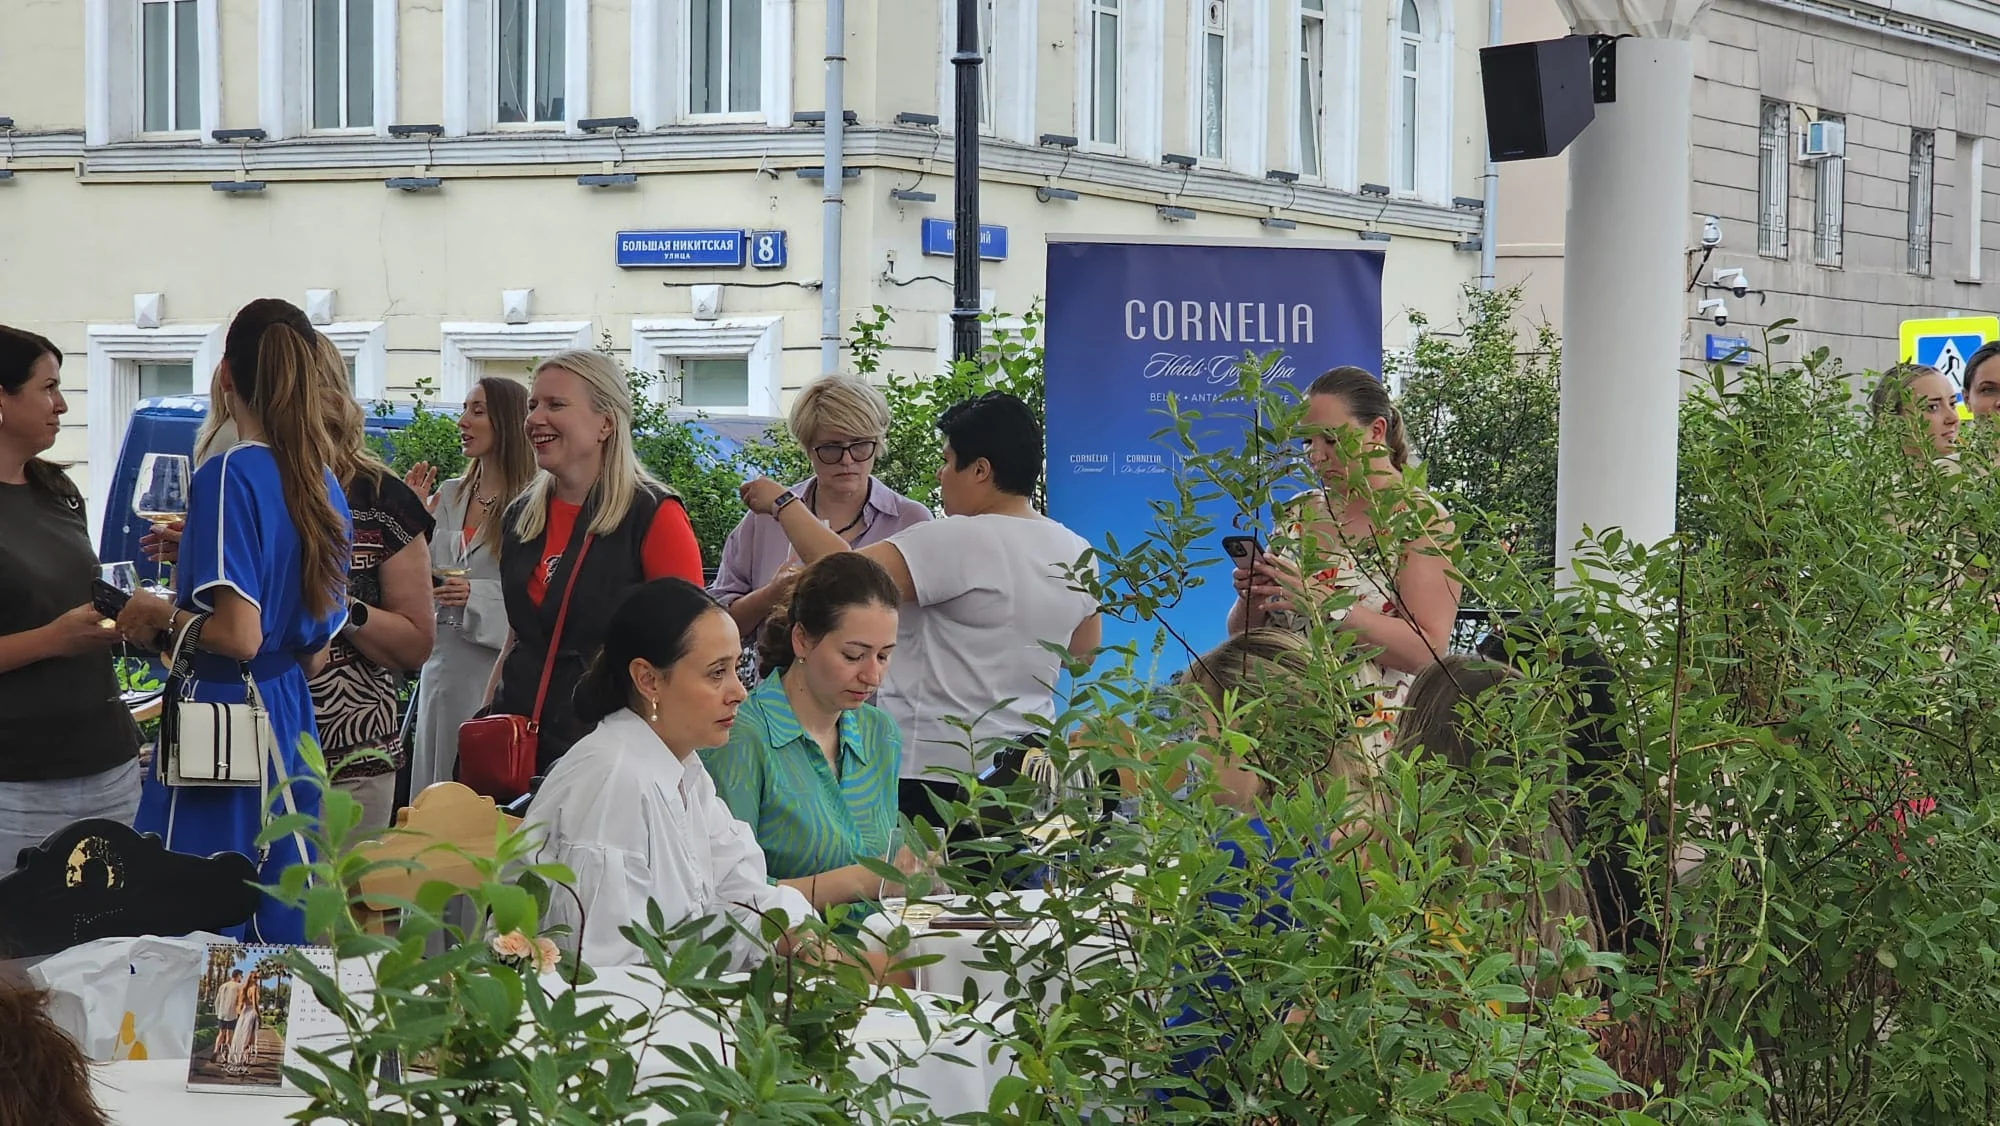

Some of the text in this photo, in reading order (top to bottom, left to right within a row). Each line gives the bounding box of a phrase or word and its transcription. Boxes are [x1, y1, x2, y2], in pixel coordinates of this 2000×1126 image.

[622, 239, 734, 251] БОЛЬШАЯ НИКИТСКАЯ
[758, 236, 774, 262] 8
[664, 252, 691, 260] УЛИЦА
[1125, 299, 1314, 344] CORNELIA
[1143, 352, 1205, 379] Hotels
[1150, 392, 1181, 402] BELK
